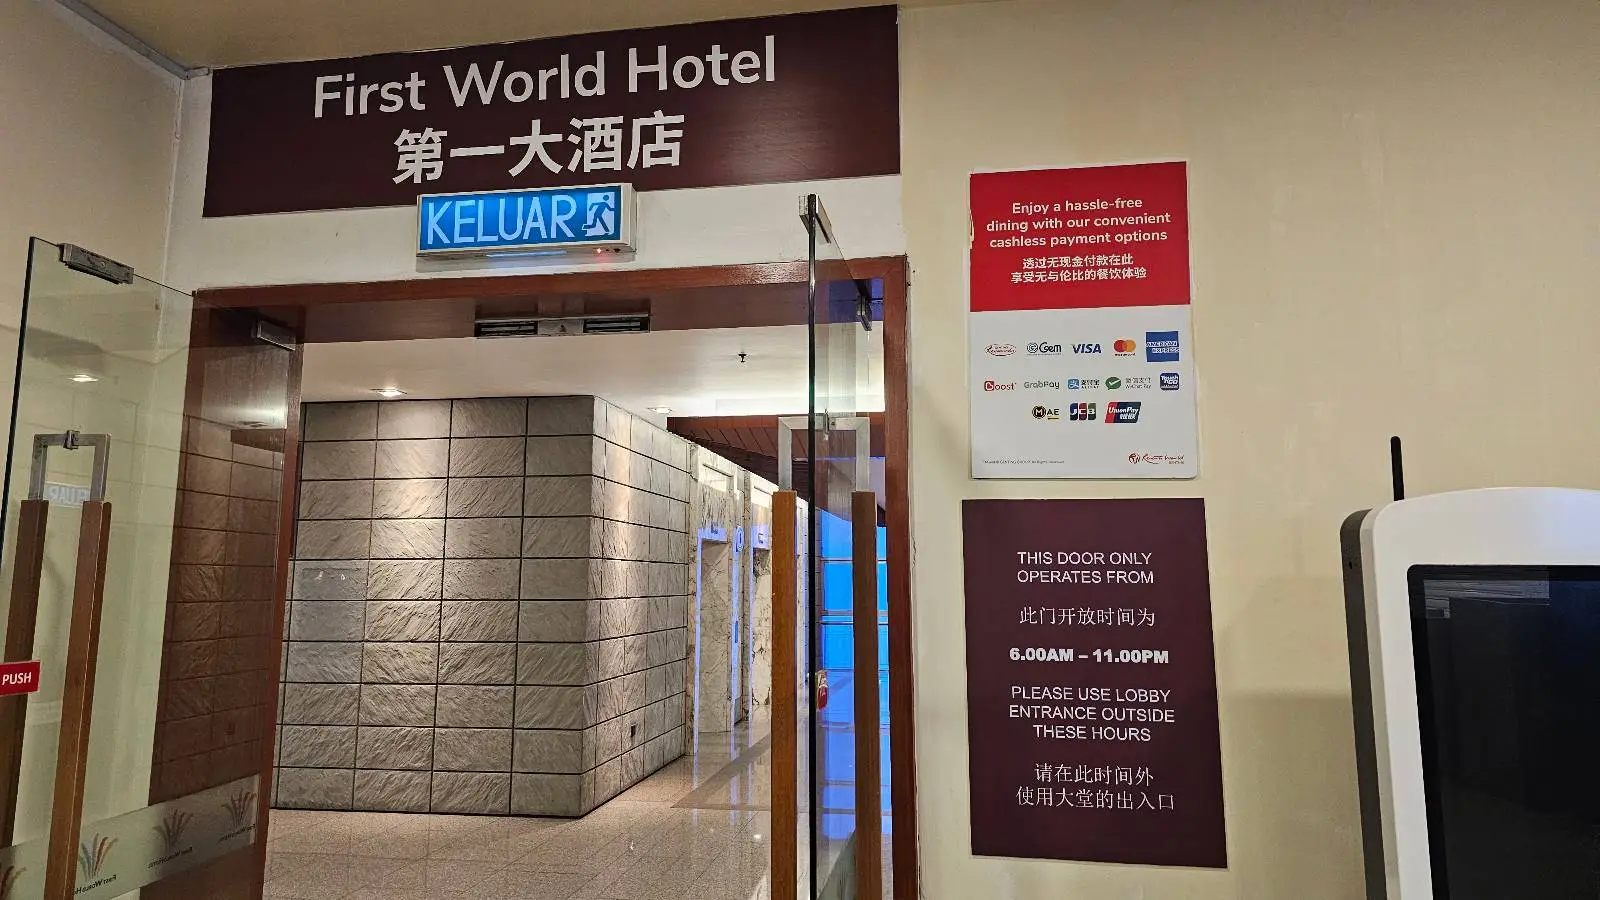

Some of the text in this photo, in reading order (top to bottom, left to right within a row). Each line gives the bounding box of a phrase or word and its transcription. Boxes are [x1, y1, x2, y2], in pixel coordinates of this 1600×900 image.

[314, 35, 777, 118] First World Hotel
[392, 110, 685, 185] 第一大酒店
[1012, 198, 1143, 215] Enjoy a hassle-free
[426, 195, 576, 247] KELUAR
[986, 212, 1171, 233] dining with our convenient
[989, 230, 1168, 248] cashless payment options
[1022, 253, 1134, 270] 透过无现金付款在此
[1010, 267, 1147, 284] 享受无与伦比的餐饮体验
[1072, 343, 1102, 354] VISA
[1023, 380, 1060, 390] GrabPay
[1108, 407, 1139, 415] UnionPay
[1017, 552, 1152, 566] THIS DOOR ONLY
[1017, 570, 1154, 584] OPERATES FROM
[1019, 606, 1156, 627] 此门开放时间为
[1009, 647, 1074, 662] 6.00AM
[1093, 649, 1169, 664] 11.00PM
[2, 672, 32, 685] PUSH
[1011, 686, 1171, 703] PLEASE USE LOBBY
[1009, 705, 1175, 723] ENTRANCE OUTSIDE
[1033, 725, 1151, 742] THESE HOURS
[1033, 762, 1154, 787] 请在此时间外
[1015, 786, 1175, 811] 使用大堂的出入口
